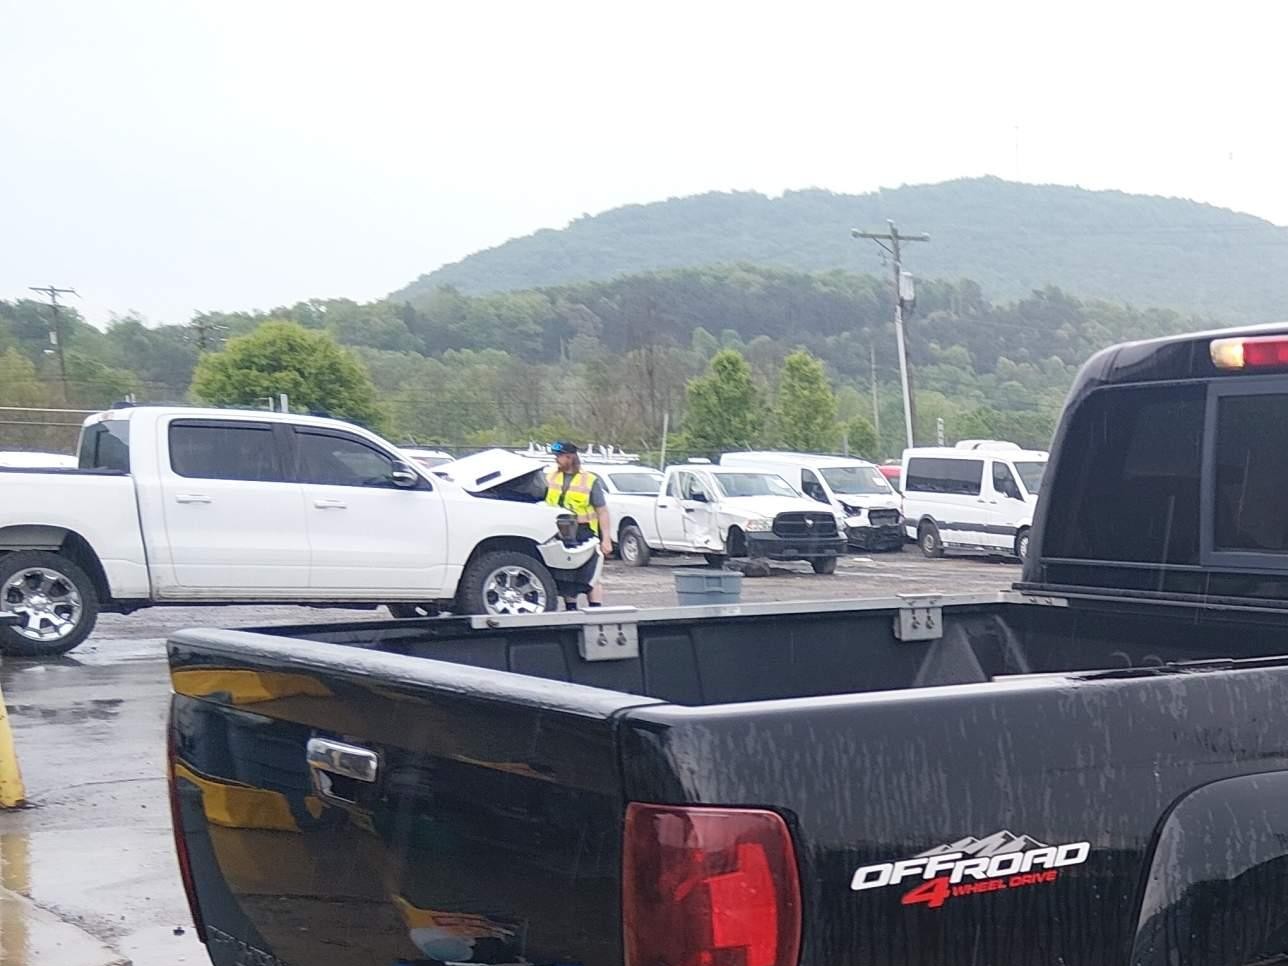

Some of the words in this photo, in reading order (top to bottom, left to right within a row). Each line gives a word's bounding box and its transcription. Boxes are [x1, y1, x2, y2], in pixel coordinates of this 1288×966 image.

[850, 841, 1091, 892] OFFROAD
[901, 877, 950, 908] 4
[952, 878, 1008, 897] WHEEL
[1008, 869, 1059, 887] DRIVE
